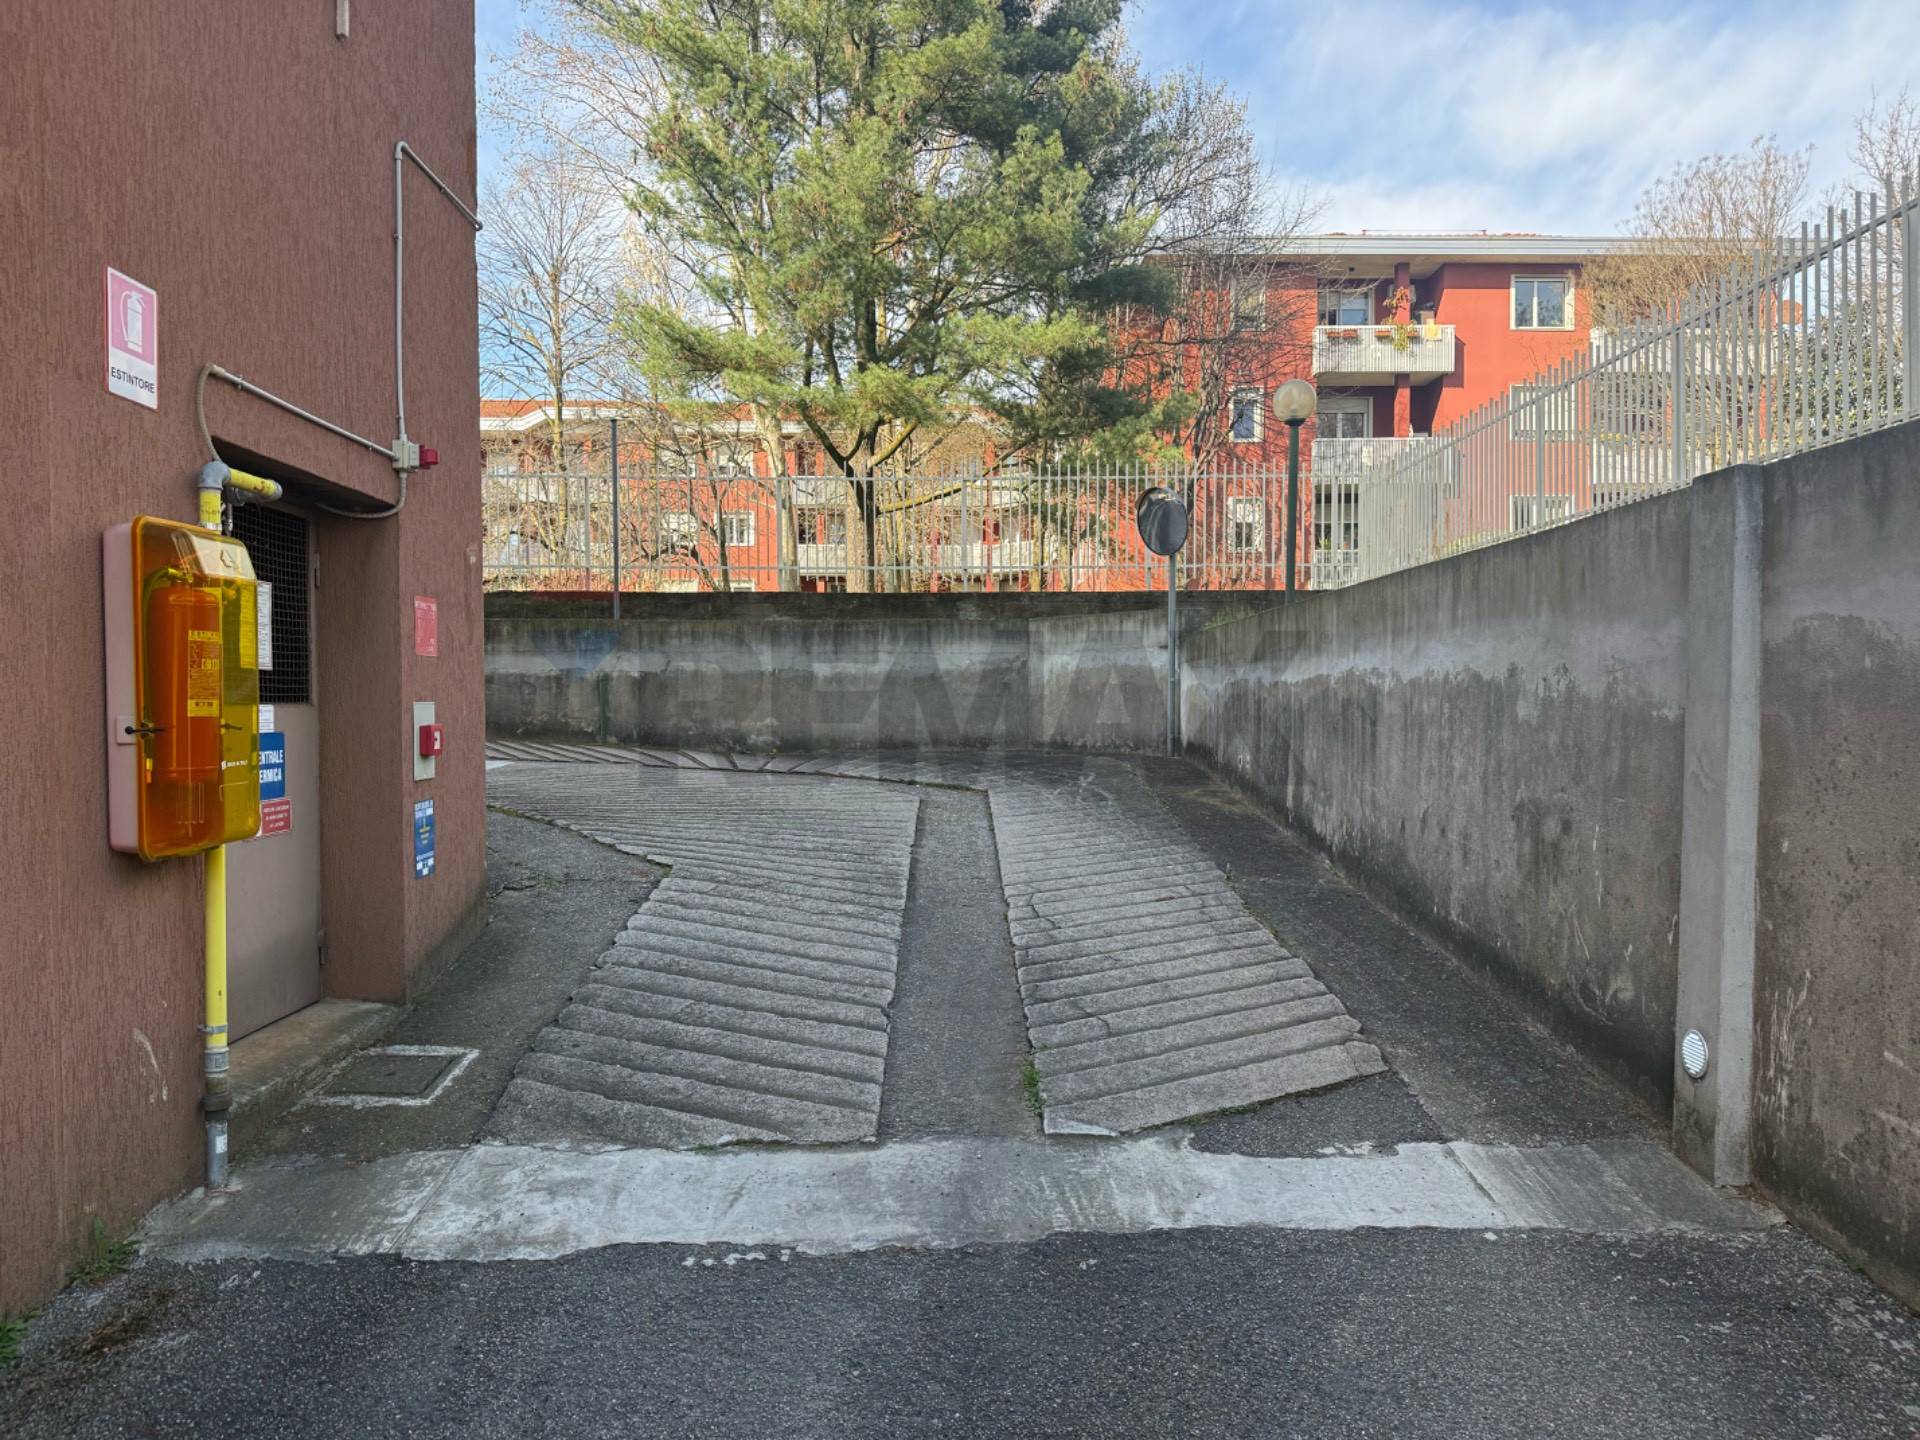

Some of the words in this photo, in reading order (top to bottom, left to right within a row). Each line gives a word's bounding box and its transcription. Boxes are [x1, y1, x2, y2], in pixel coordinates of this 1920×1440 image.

[111, 366, 155, 394] ESTINTORE
[258, 749, 284, 765] ENTRALE
[259, 767, 282, 784] ERMICA
